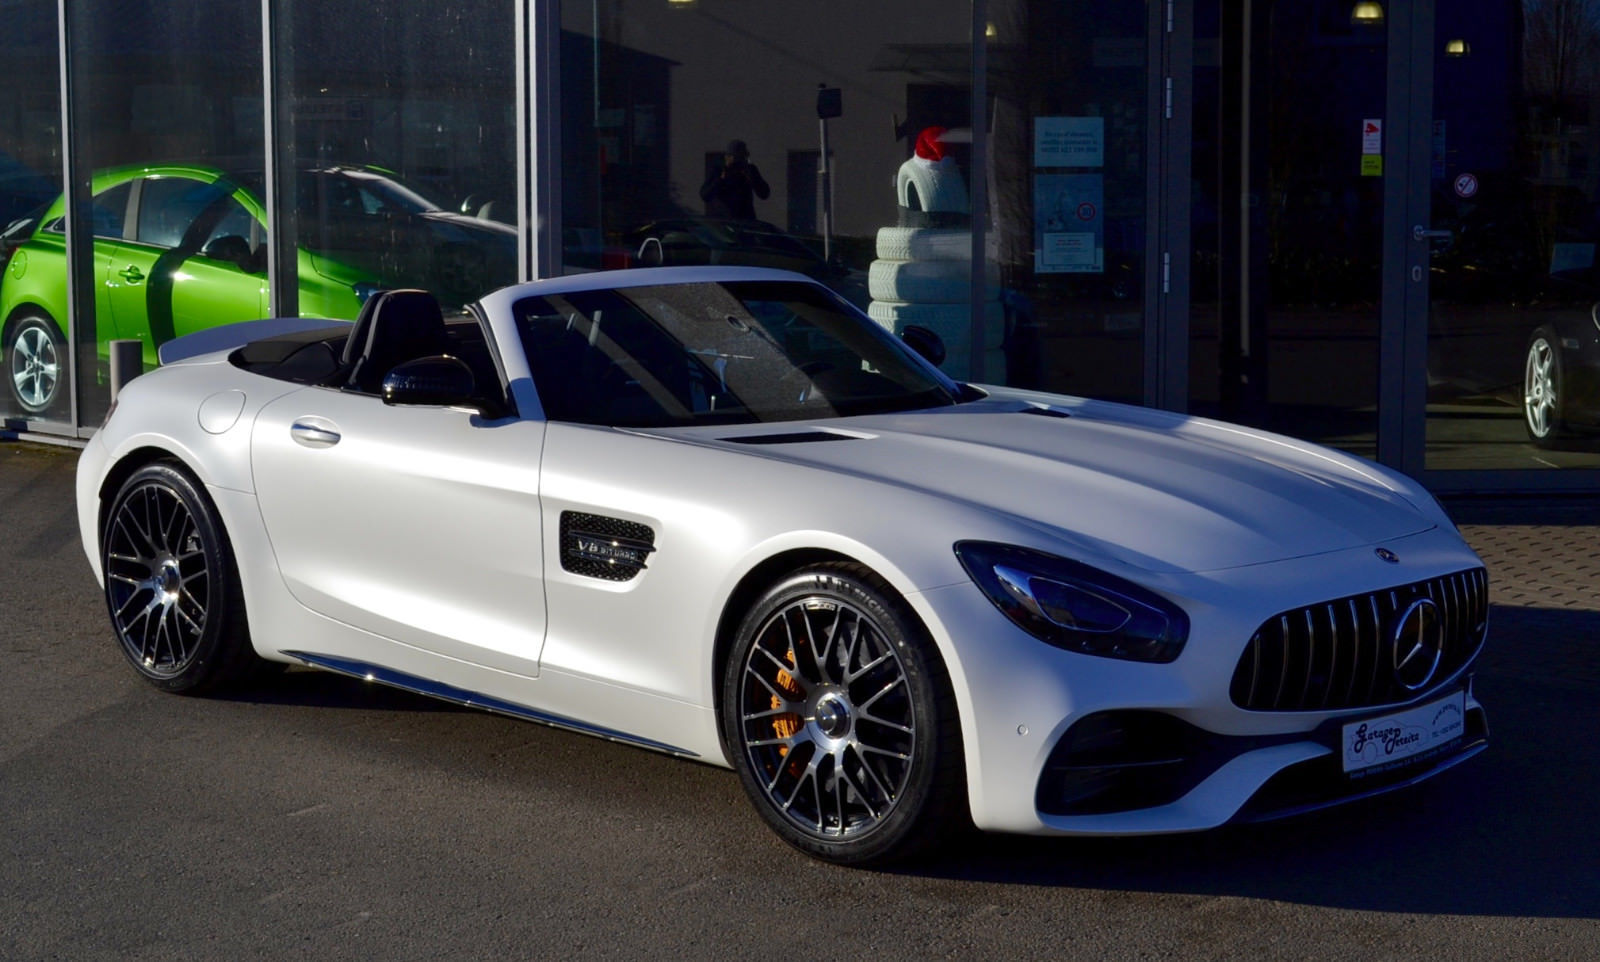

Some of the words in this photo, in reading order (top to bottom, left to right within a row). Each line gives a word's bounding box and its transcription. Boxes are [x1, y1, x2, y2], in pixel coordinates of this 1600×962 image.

[577, 539, 598, 552] V8
[1354, 723, 1393, 754] Garage
[1385, 727, 1420, 755] Pereira
